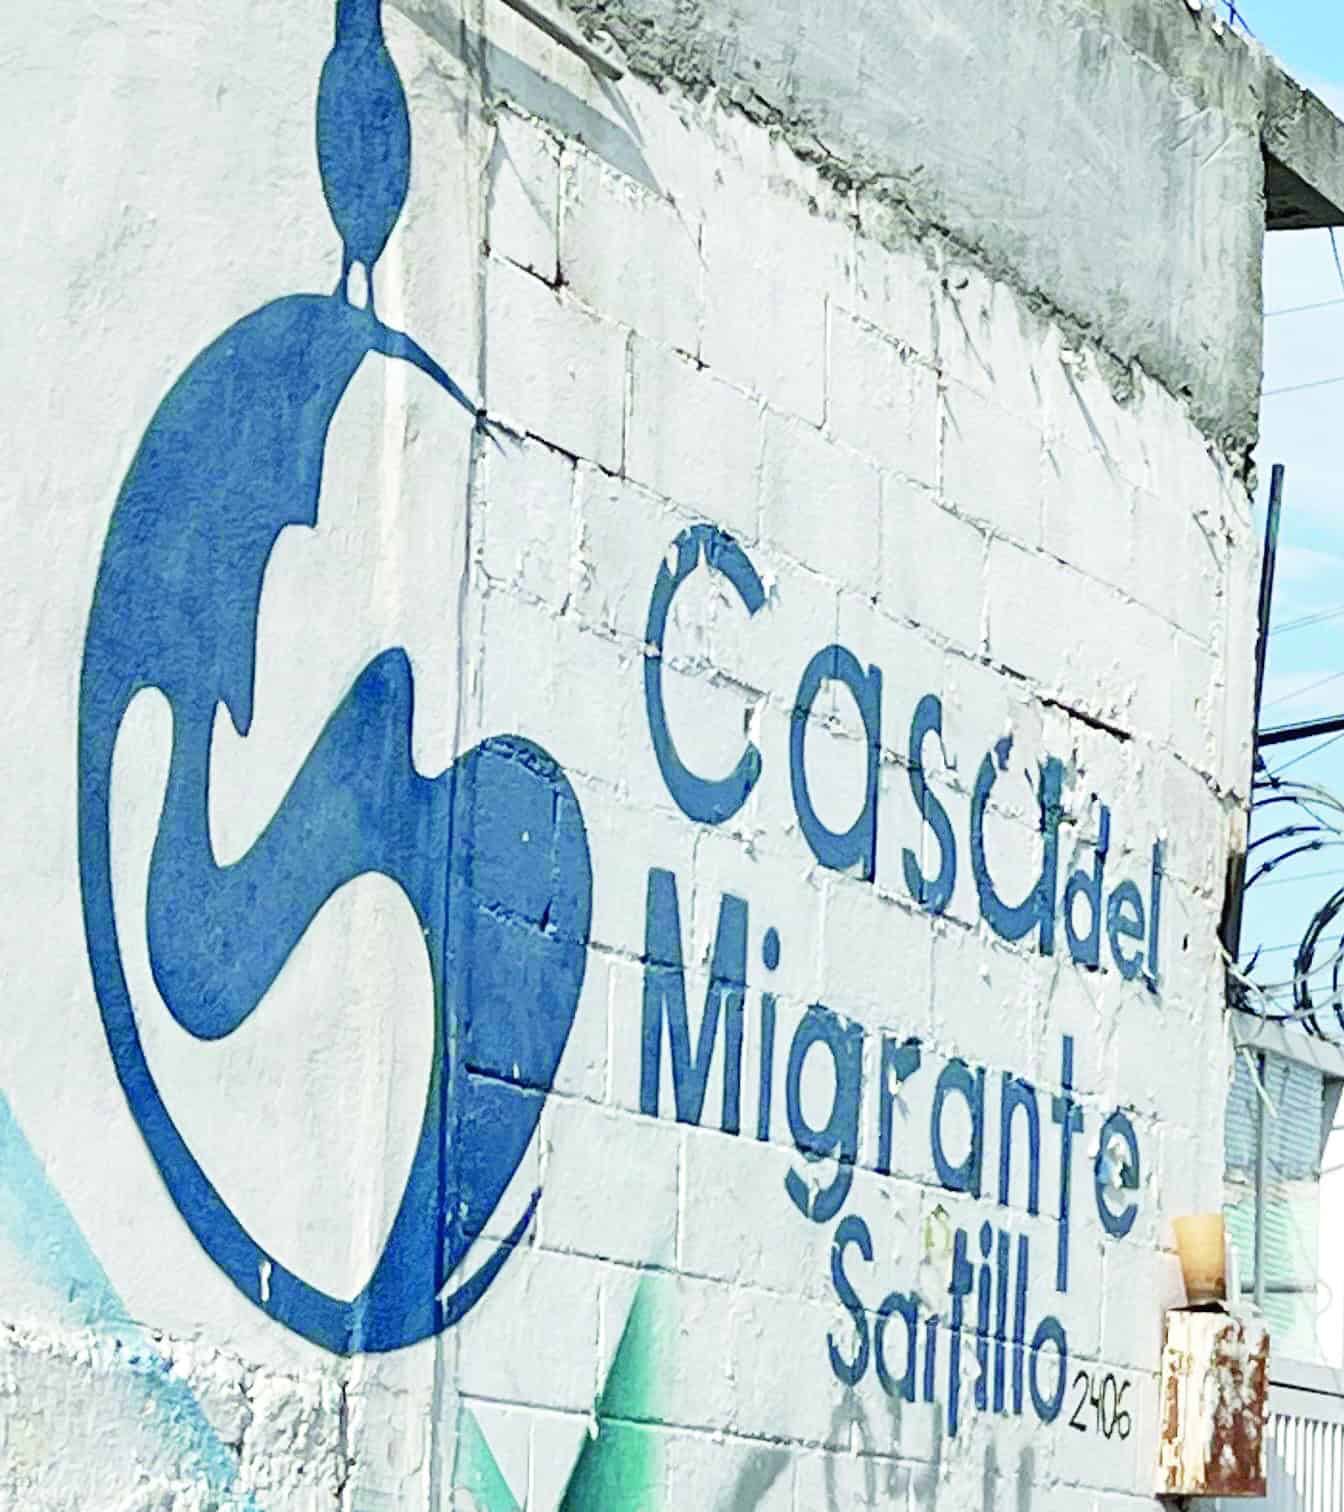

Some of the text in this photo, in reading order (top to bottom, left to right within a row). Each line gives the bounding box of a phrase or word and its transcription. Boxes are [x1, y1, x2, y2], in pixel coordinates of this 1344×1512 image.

[644, 522, 1163, 982] Casa del
[640, 866, 1140, 1292] Migrante
[1069, 1369, 1131, 1440] 2406
